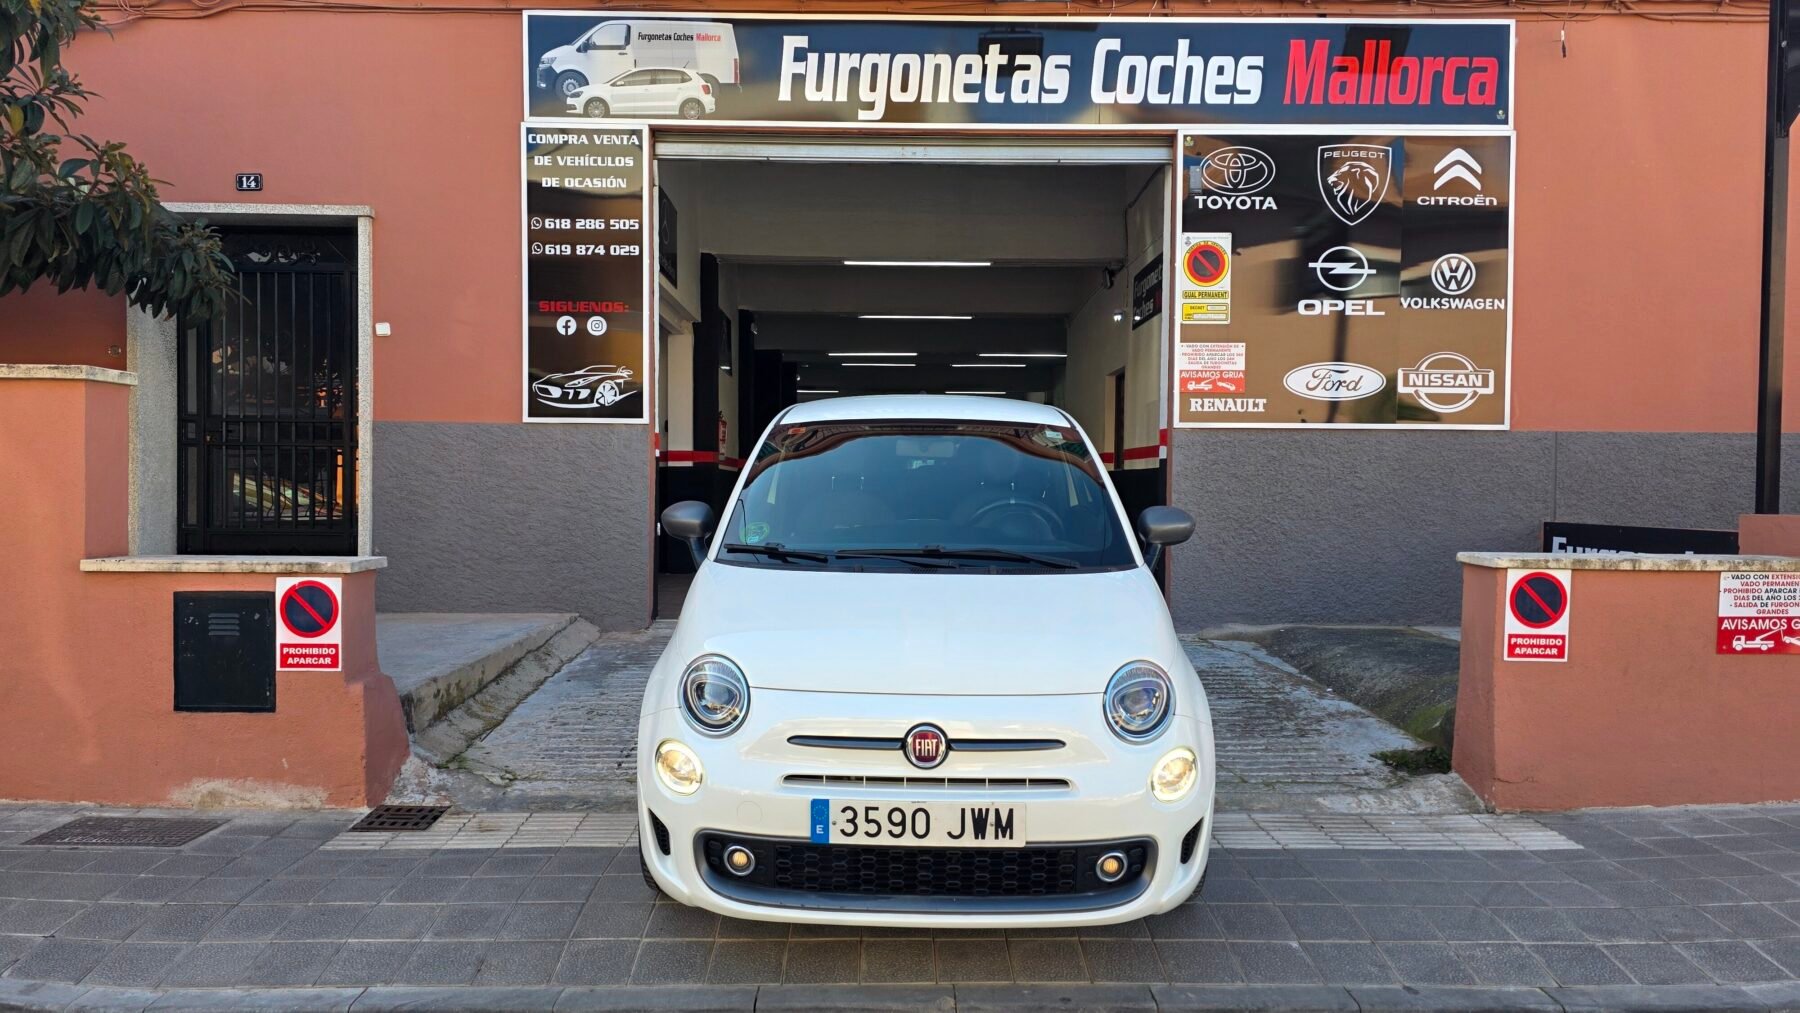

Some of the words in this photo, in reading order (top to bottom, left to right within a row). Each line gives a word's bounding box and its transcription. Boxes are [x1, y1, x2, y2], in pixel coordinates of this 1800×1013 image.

[638, 32, 672, 42] Furgonetas
[673, 32, 694, 41] Coches
[778, 36, 1072, 120] Furgonetas
[1090, 38, 1264, 105] Coches
[1282, 38, 1500, 106] Mallorca
[528, 133, 589, 145] COMPRA
[592, 134, 640, 145] VENTA
[534, 156, 552, 166] DE
[556, 154, 634, 167] VEHÍCULOS
[1323, 150, 1386, 160] PEUGEOT
[241, 176, 257, 188] 14
[542, 177, 560, 188] DE
[564, 176, 627, 188] OCASIÓN
[1194, 195, 1278, 211] TOYOTA
[544, 218, 571, 230] 618
[575, 218, 605, 230] 286
[610, 219, 640, 230] 505
[545, 244, 571, 255] 619
[576, 244, 606, 255] 874
[610, 245, 640, 256] 029
[538, 300, 630, 313] SIGUENOS:
[1297, 299, 1386, 316] OPEL
[1400, 297, 1505, 310] VOLKSWAGEN
[1305, 368, 1364, 393] Ford
[1408, 373, 1483, 387] NISSAN
[1189, 398, 1267, 412] RENAULT
[1721, 619, 1788, 630] AVISAMOS
[1510, 638, 1563, 646] PROHIBIDO
[1514, 647, 1558, 656] APARCAR
[915, 738, 938, 757] FIAT
[816, 825, 824, 834] E
[839, 805, 931, 839] 3590
[947, 808, 1014, 840] JWM
